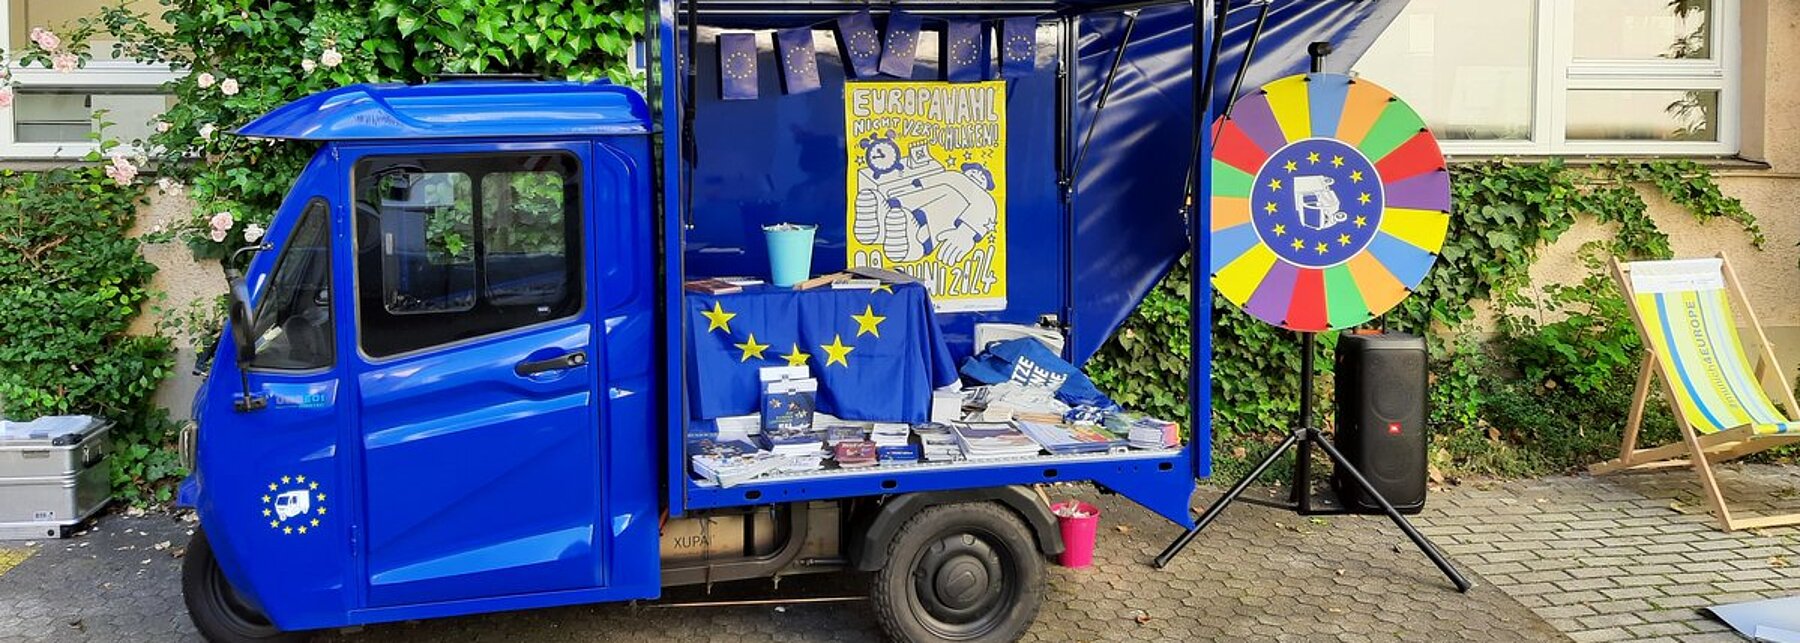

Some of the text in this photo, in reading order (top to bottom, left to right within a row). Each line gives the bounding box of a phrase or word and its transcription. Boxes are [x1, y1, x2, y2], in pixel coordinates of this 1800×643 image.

[852, 87, 999, 125] EUROPAWAHL
[853, 117, 999, 151] NICHT VERSCHLAFEN!
[949, 244, 998, 297] 2024
[1011, 355, 1035, 387] TZE
